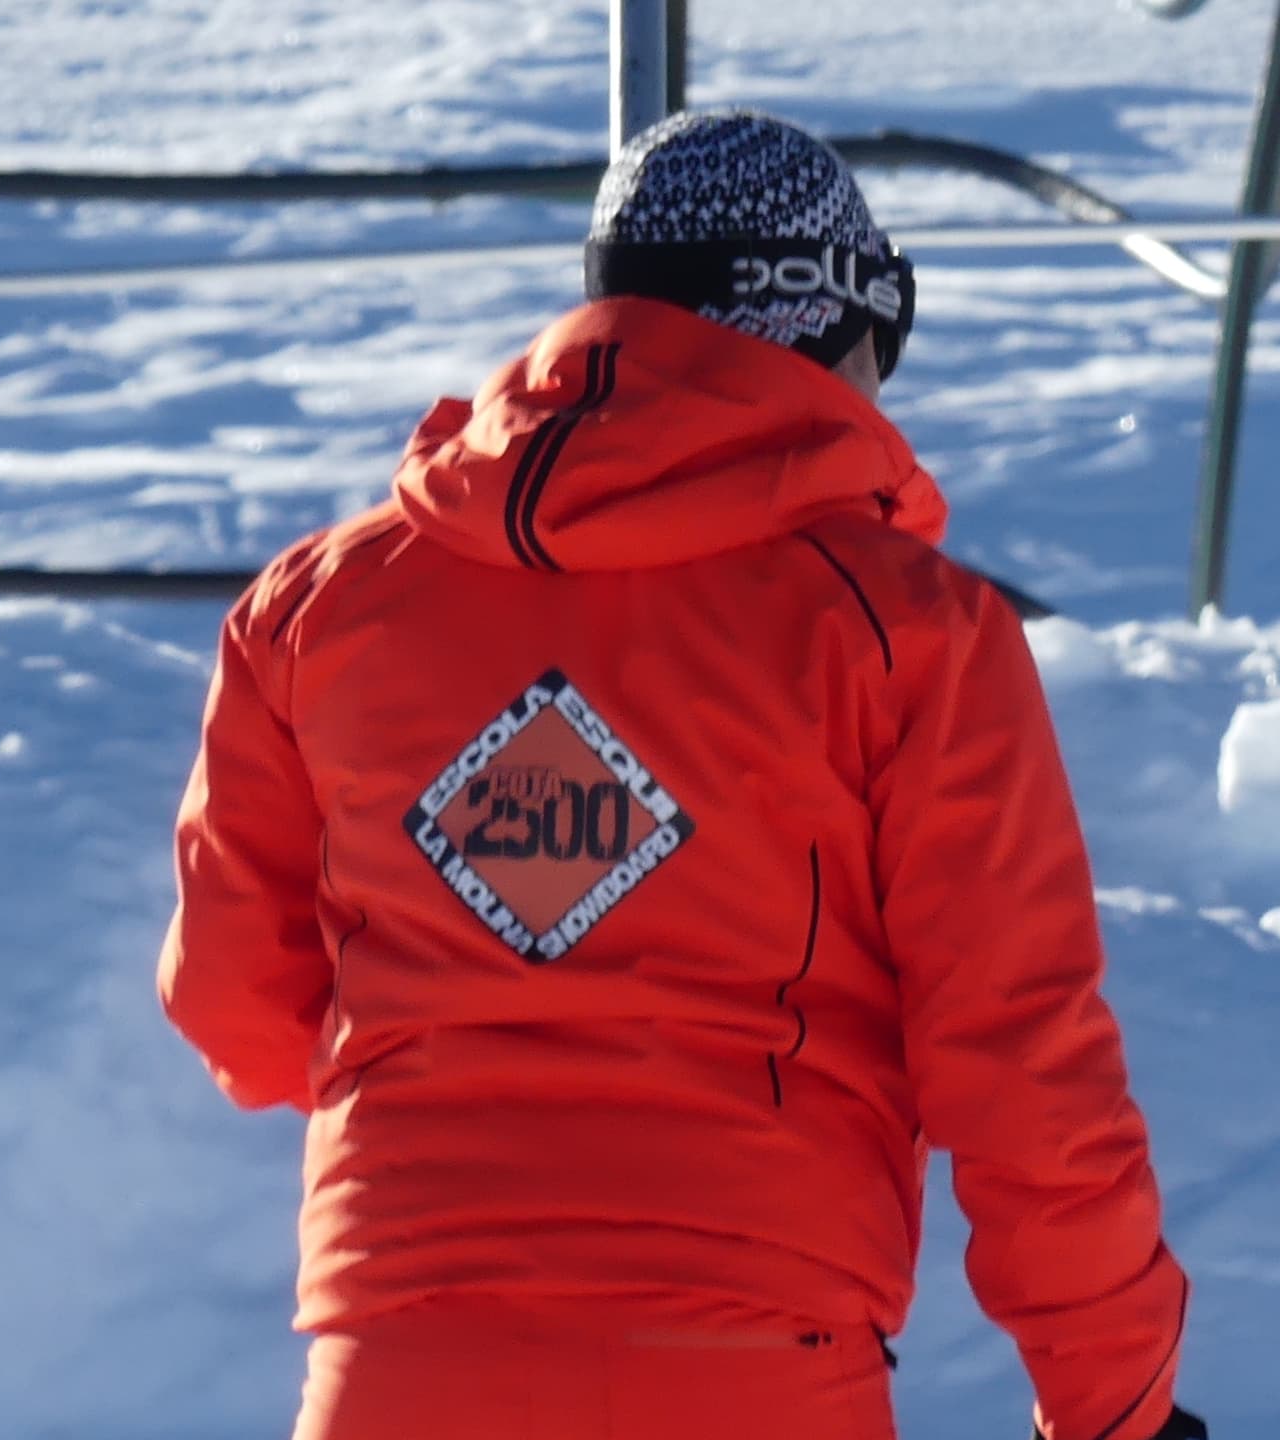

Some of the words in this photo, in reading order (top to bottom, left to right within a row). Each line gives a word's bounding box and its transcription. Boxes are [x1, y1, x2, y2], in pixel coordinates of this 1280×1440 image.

[420, 683, 553, 817] ESCOLA
[463, 779, 630, 861] 2500
[416, 821, 450, 865] LA
[442, 855, 534, 955] MOLINA
